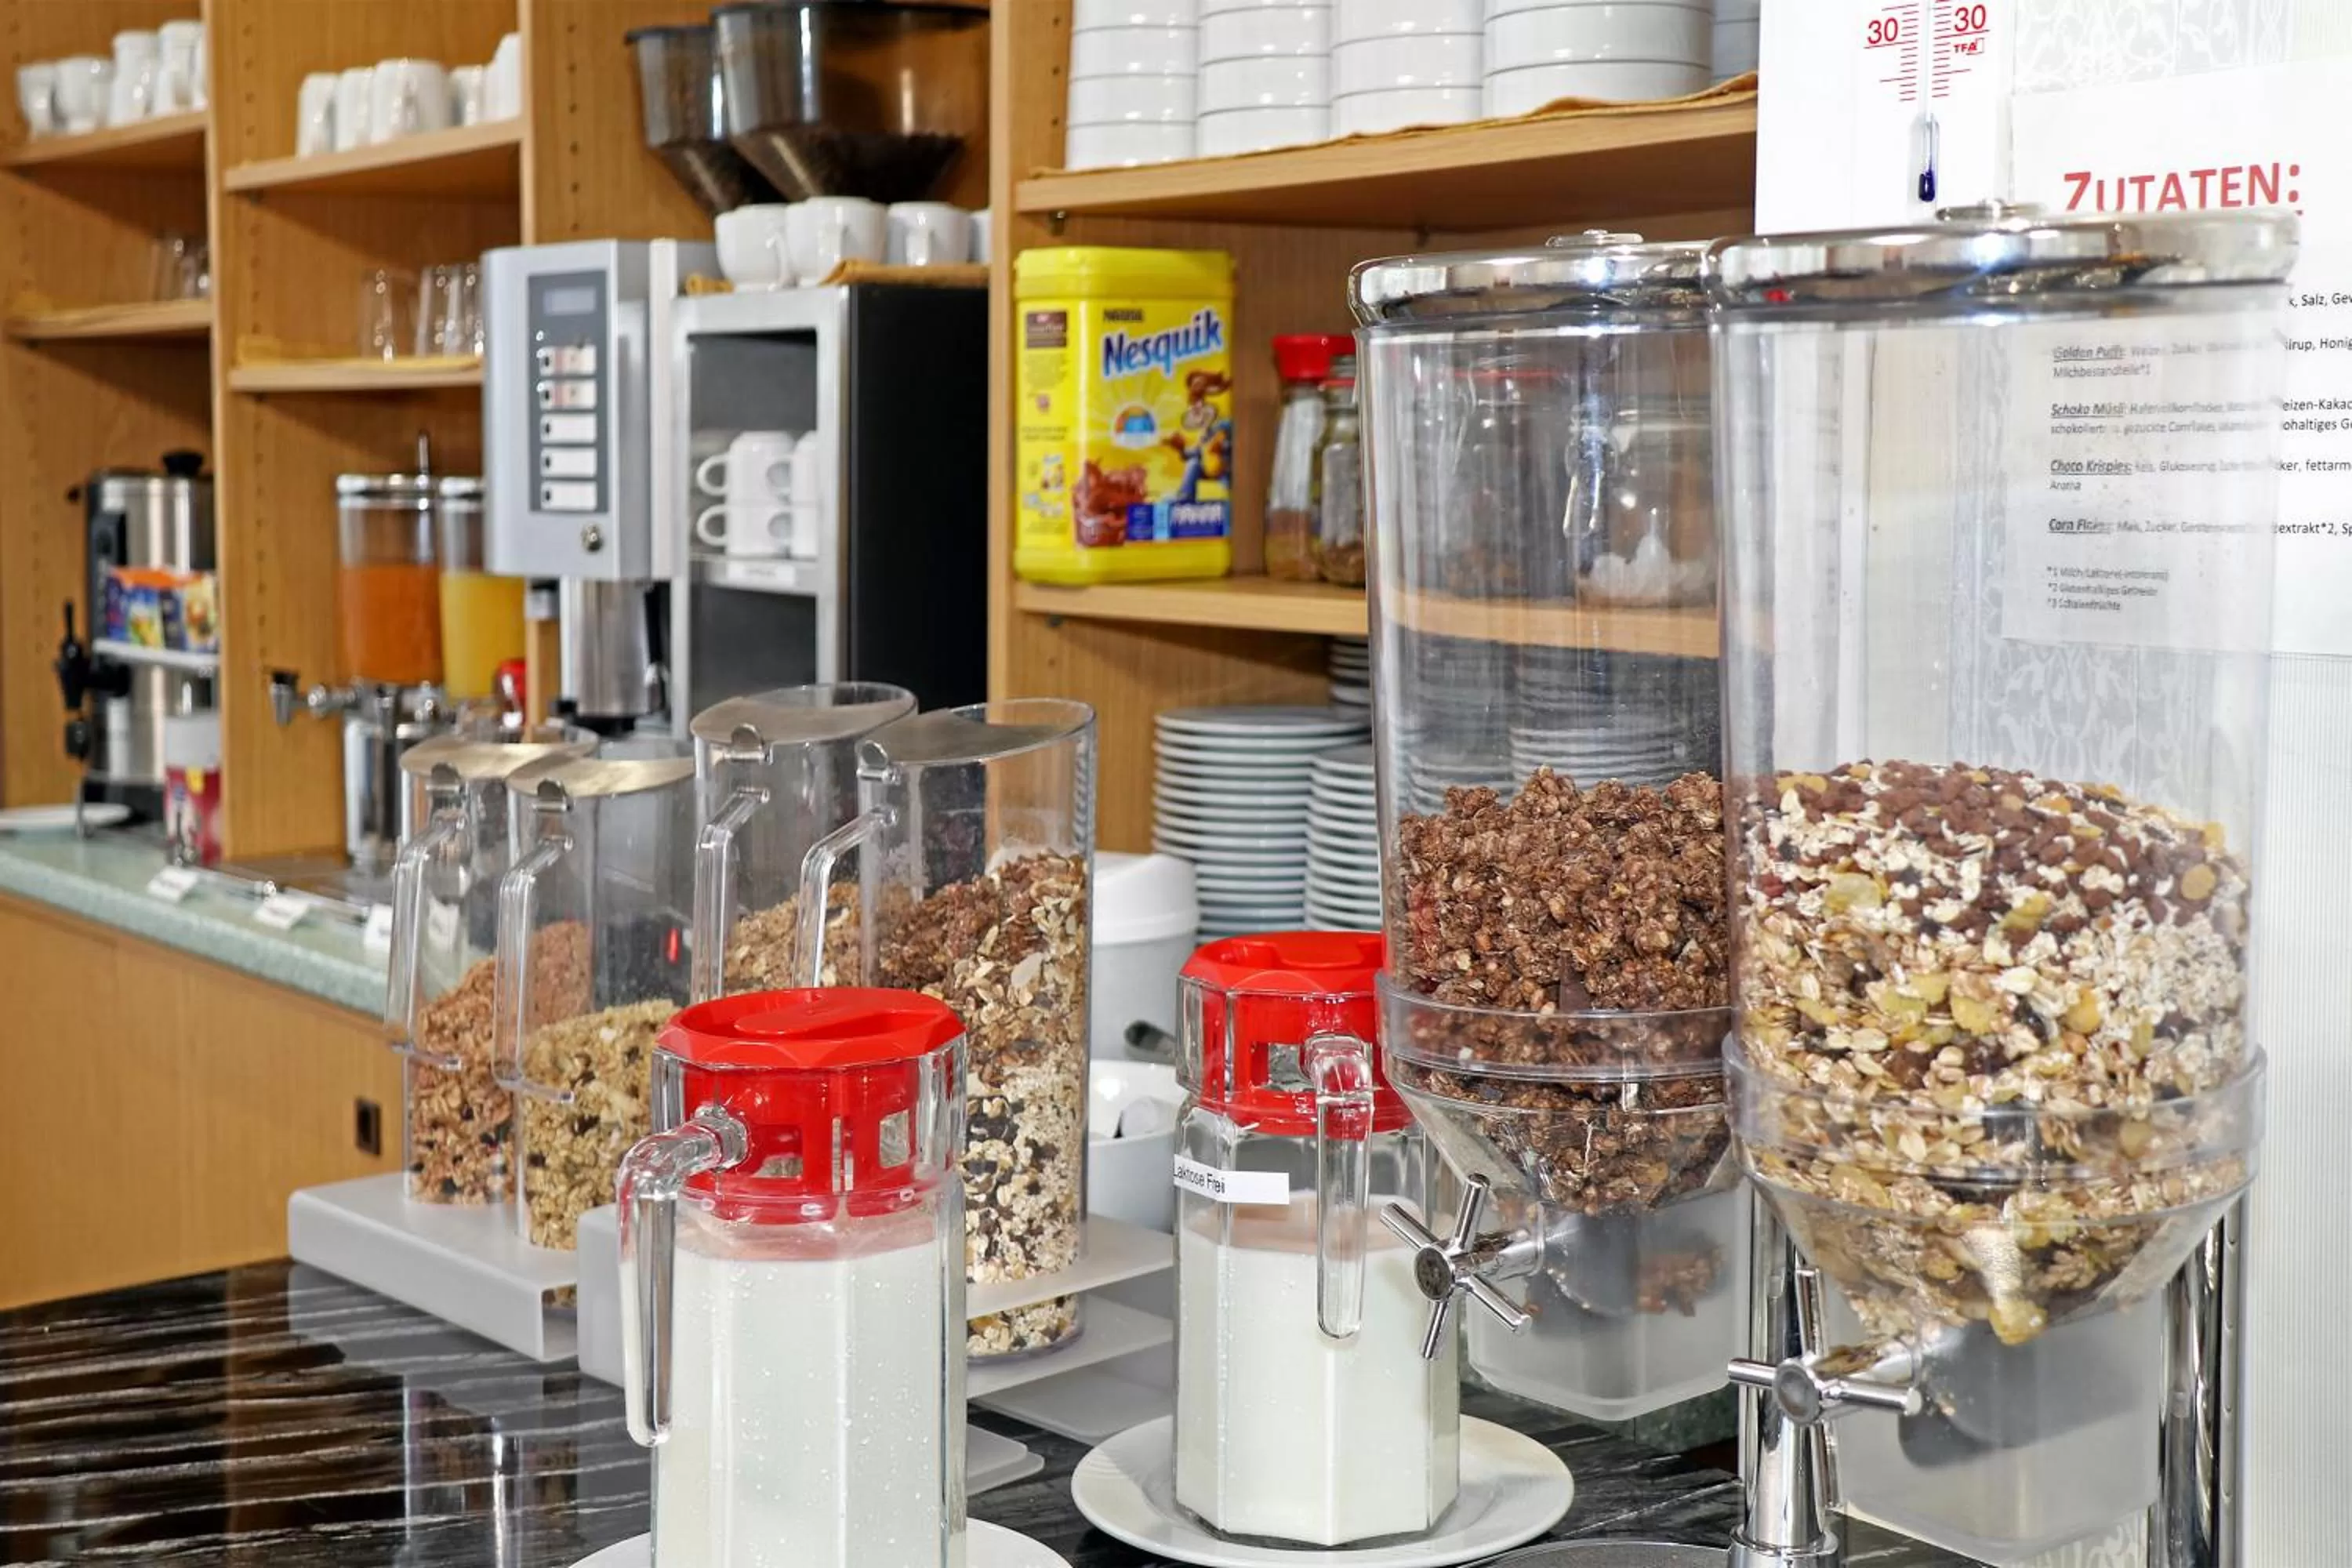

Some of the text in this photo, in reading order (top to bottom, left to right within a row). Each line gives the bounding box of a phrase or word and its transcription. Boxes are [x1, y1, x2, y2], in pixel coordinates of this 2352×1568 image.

[1954, 4, 1987, 32] 30
[1867, 20, 1898, 45] 30
[2063, 162, 2301, 214] ZUTATEN:
[2301, 294, 2328, 307] Salz,
[1102, 308, 1223, 378] Nesquik
[2282, 397, 2352, 411] eizen-Kakao
[2282, 418, 2337, 434] ohaltiges
[2051, 459, 2083, 474] Choco
[1207, 1172, 1225, 1194] Frei
